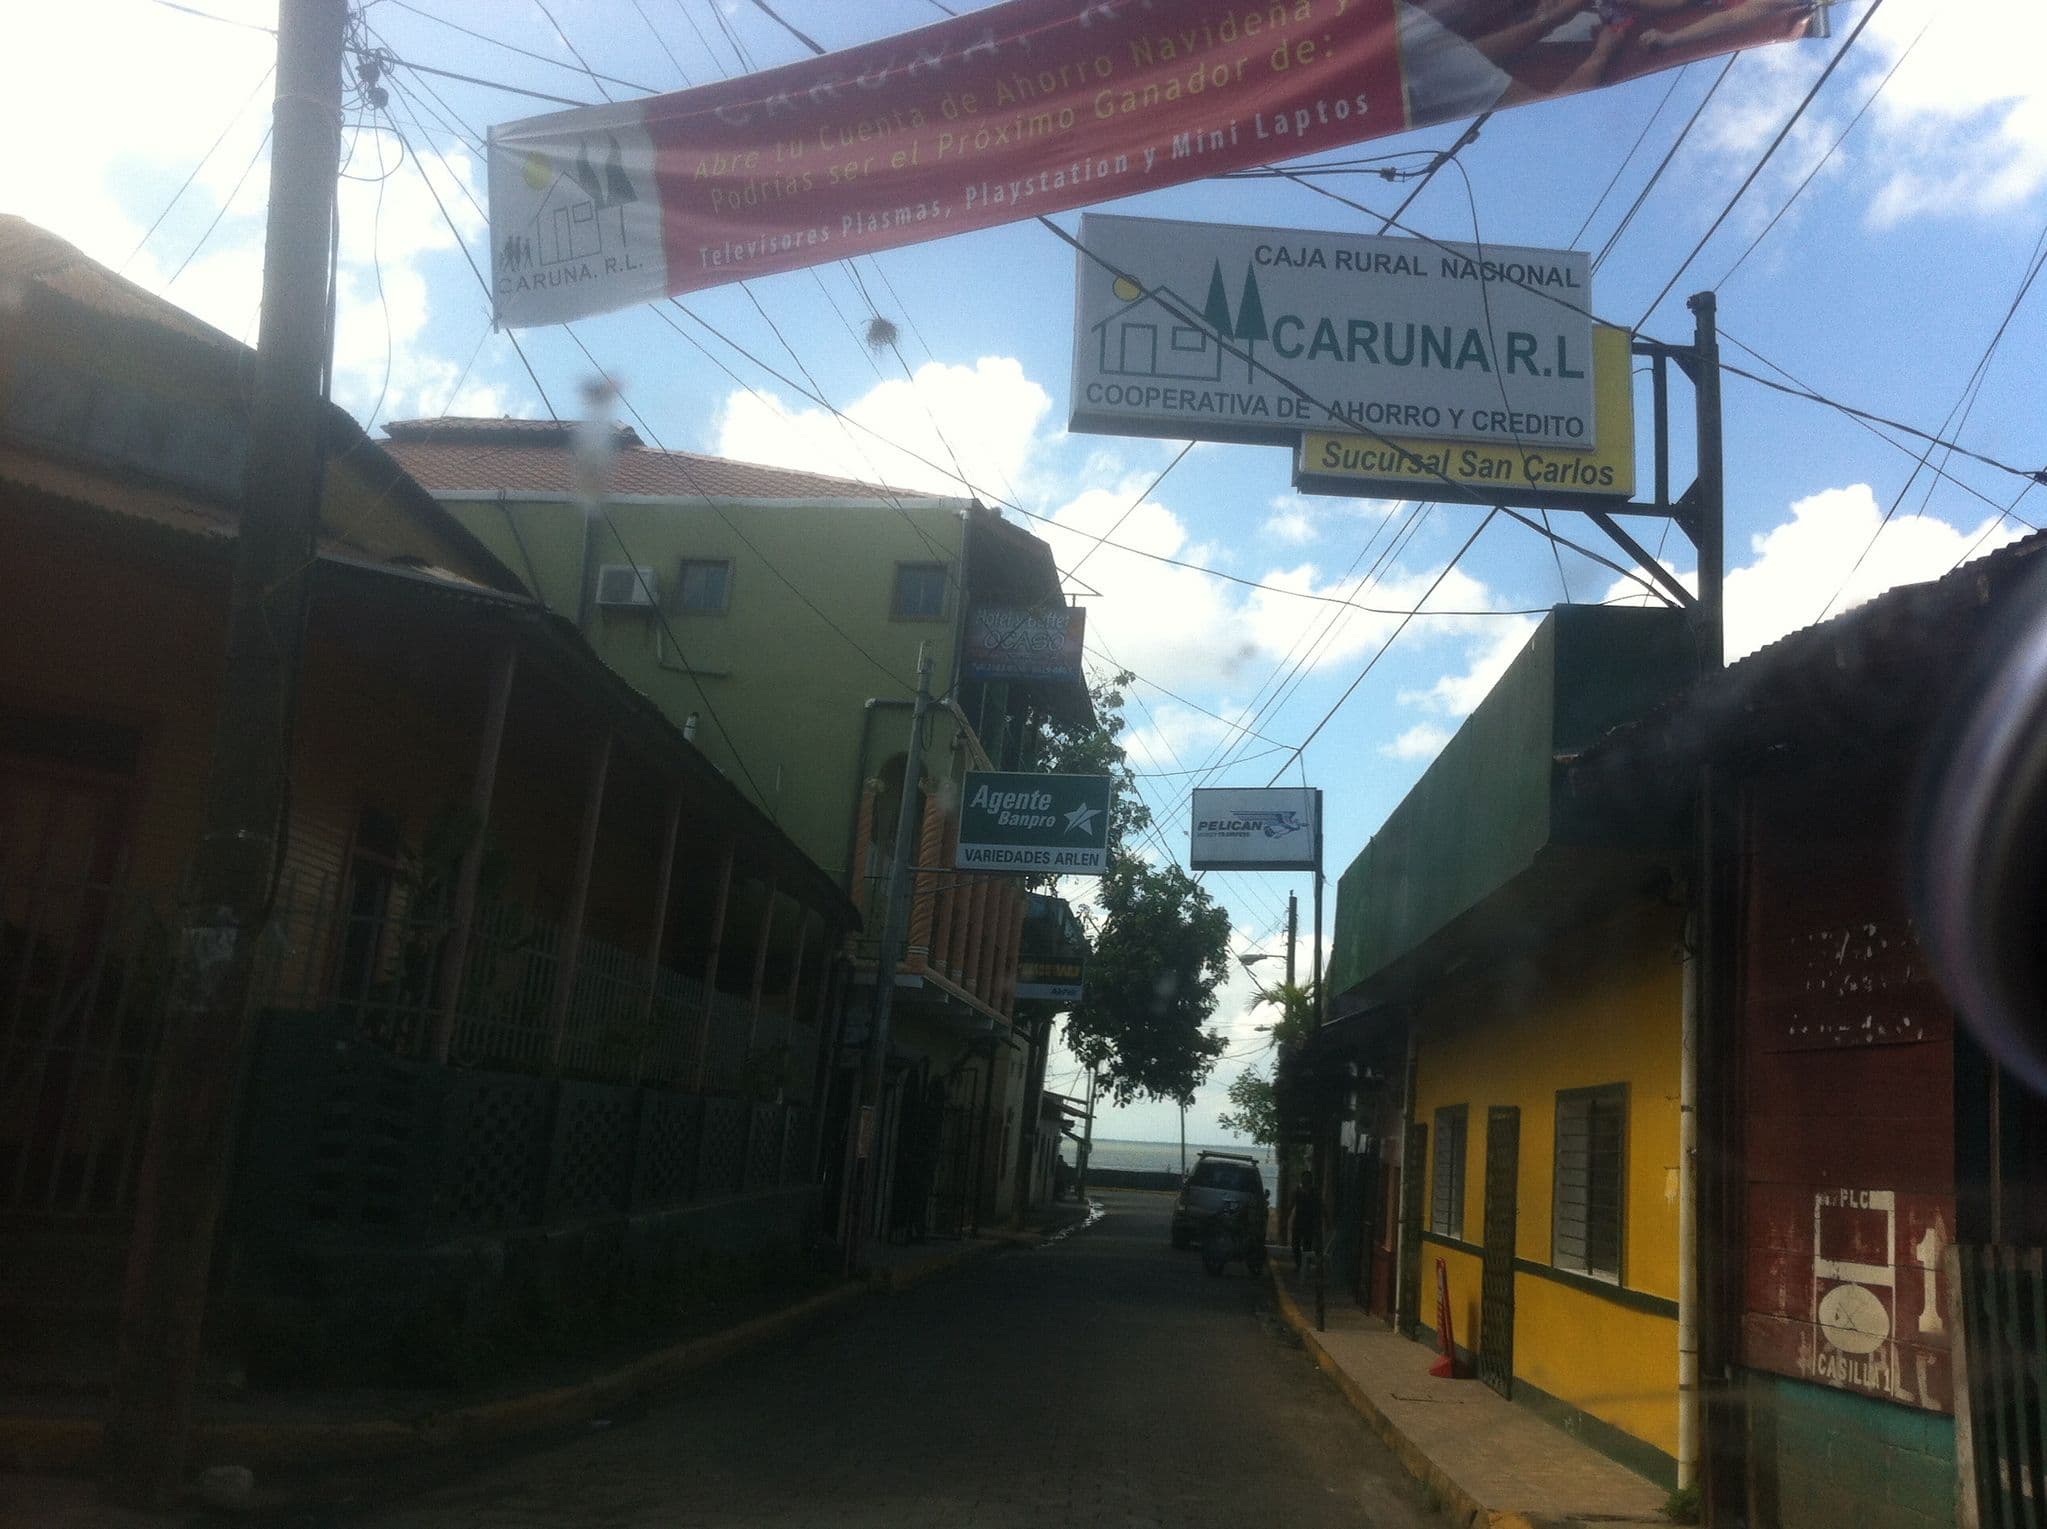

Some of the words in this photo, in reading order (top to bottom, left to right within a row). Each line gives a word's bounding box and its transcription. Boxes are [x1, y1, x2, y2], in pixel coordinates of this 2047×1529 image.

[694, 150, 760, 182] Abre
[819, 106, 926, 152] Cuenta
[941, 92, 978, 121] de
[996, 55, 1114, 107] Ahorro
[829, 152, 875, 185] ser
[891, 139, 920, 169] el
[937, 107, 1075, 160] Próximo
[1094, 55, 1249, 120] Ganador
[1271, 34, 1333, 72] de:
[699, 223, 830, 269] Televisores
[842, 199, 952, 238] Plasmas,
[965, 153, 1129, 210] Playstation
[1143, 145, 1157, 173] y
[1171, 119, 1238, 160] Mini
[1255, 93, 1369, 139] Laptos
[604, 253, 644, 275] R.L.
[1254, 244, 1328, 269] CAJA
[1335, 249, 1429, 277] RURAL
[1440, 257, 1582, 288] NACIONAL
[1272, 314, 1492, 374] CARUNA
[1506, 330, 1585, 379] R.L
[1086, 382, 1270, 416] COOPERATIVA
[1276, 396, 1311, 419] DE
[1328, 400, 1441, 428] AHORRO
[1448, 407, 1465, 430] Y
[1472, 410, 1585, 438] CREDITO
[1321, 440, 1450, 476] Sucursal
[1458, 449, 1512, 480] San
[1524, 454, 1615, 486] Carlos
[970, 784, 1053, 815] Agente
[998, 811, 1056, 830] Banpro
[1197, 820, 1263, 832] PELICAN
[964, 848, 1051, 866] VARIEDADES
[1054, 852, 1100, 867] ARLEN
[1839, 1187, 1869, 1210] PLC
[1816, 1352, 1881, 1390] CASILLA
